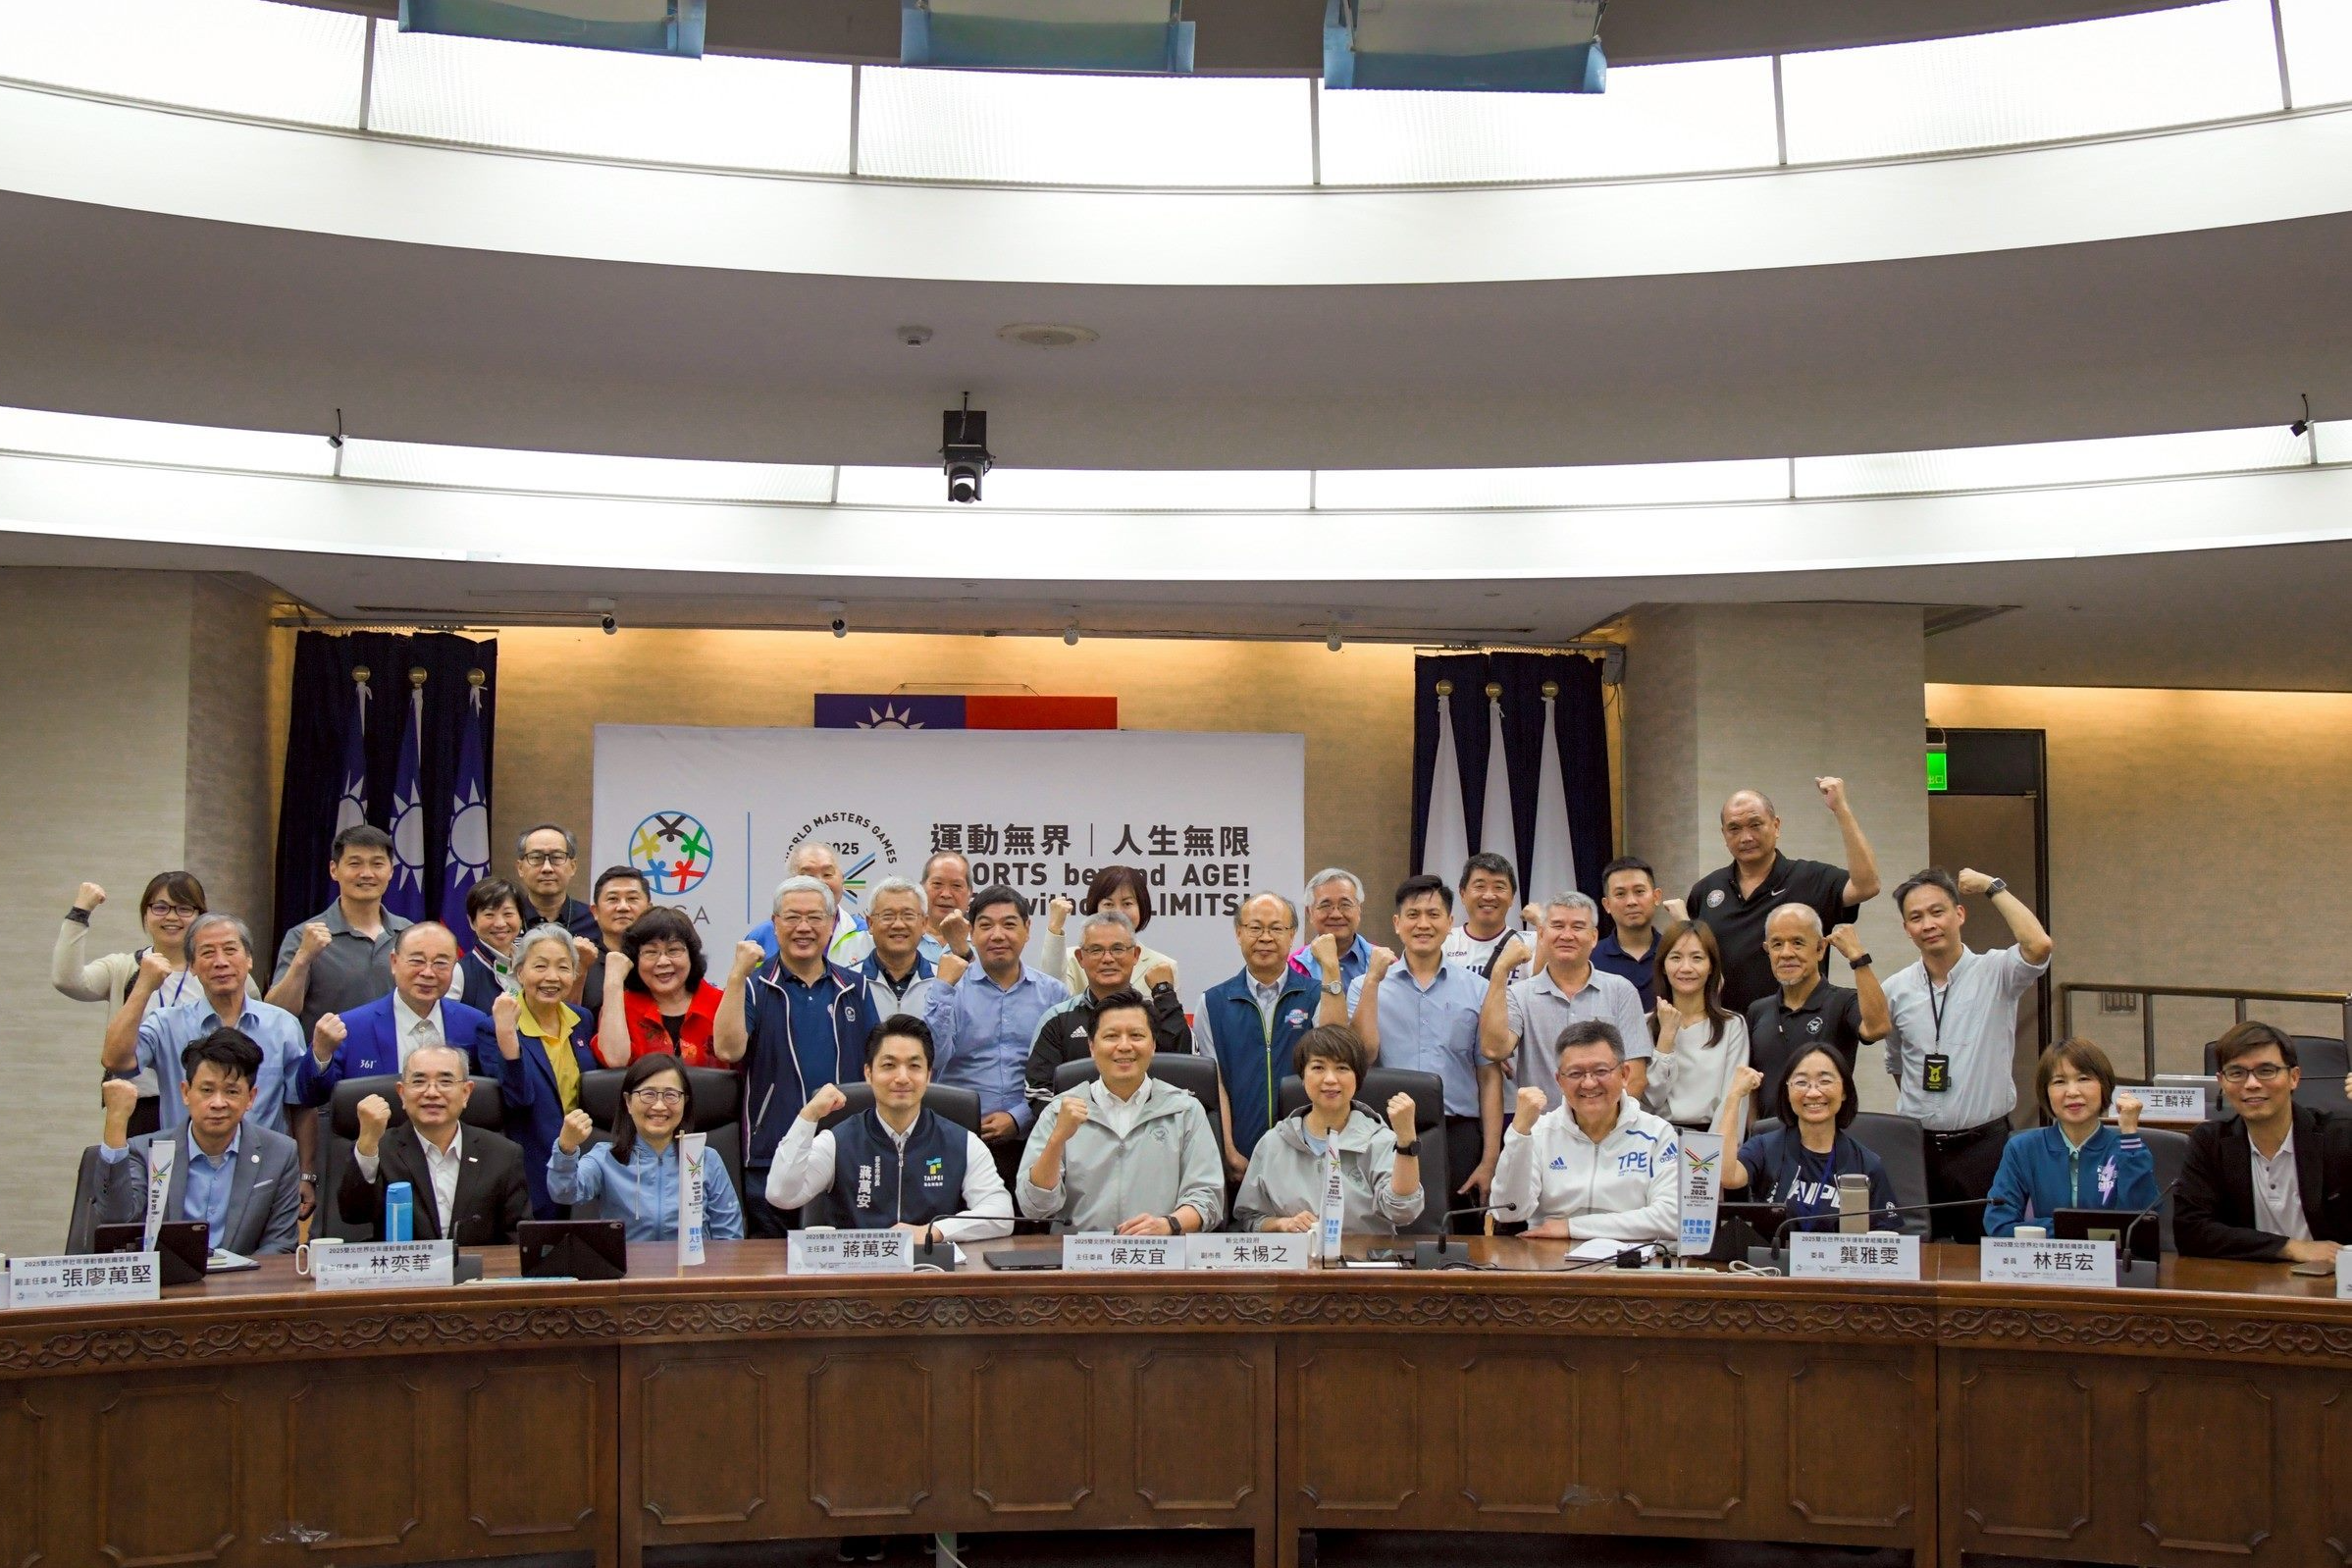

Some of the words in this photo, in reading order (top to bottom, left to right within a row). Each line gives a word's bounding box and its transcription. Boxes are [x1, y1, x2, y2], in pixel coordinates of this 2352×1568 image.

[813, 812, 871, 828] MASTERS
[871, 825, 897, 863] GAMES
[930, 822, 1071, 857] 運動無界
[1112, 823, 1250, 857] 人生無限
[826, 842, 860, 856] 025
[971, 862, 1048, 886] ORTS
[1181, 863, 1250, 887] AGE!
[1618, 1151, 1647, 1171] TPE
[843, 1239, 899, 1258] 蔣萬安
[1111, 1247, 1166, 1265] 侯友宜
[1233, 1245, 1288, 1263] 朱惕之
[1840, 1245, 1899, 1266] 龔雅雯
[370, 1254, 432, 1275] 林奕華
[2033, 1251, 2094, 1271] 林哲宏
[15, 1276, 58, 1286] 副主任委員
[62, 1264, 152, 1287] 張廖萬堅
